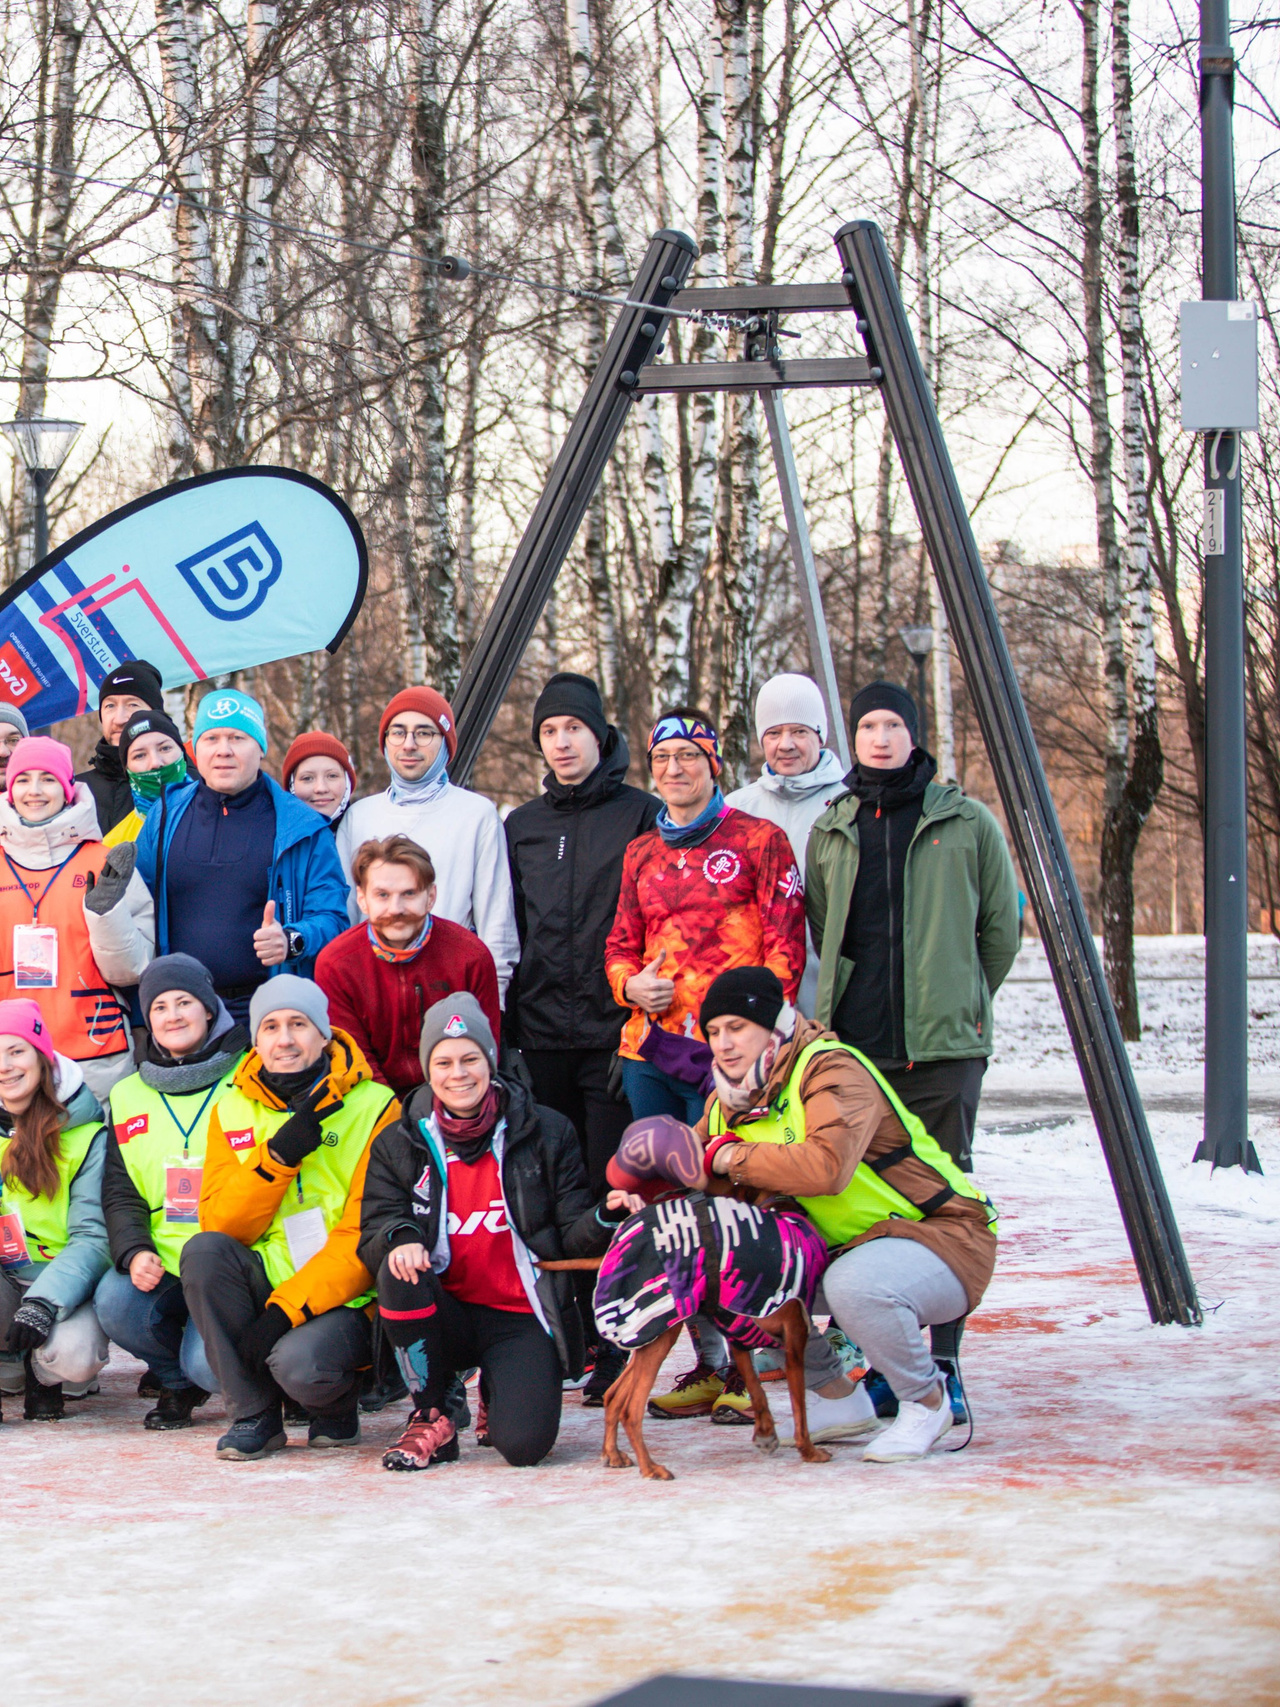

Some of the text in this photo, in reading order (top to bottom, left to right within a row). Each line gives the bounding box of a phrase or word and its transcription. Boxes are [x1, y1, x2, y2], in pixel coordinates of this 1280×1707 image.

[1208, 491, 1217, 552] 2119
[9, 632, 52, 688] ОФИЦИАЛЬНЫЙ ПАРТНЕР
[70, 611, 111, 664] 5verst.ru
